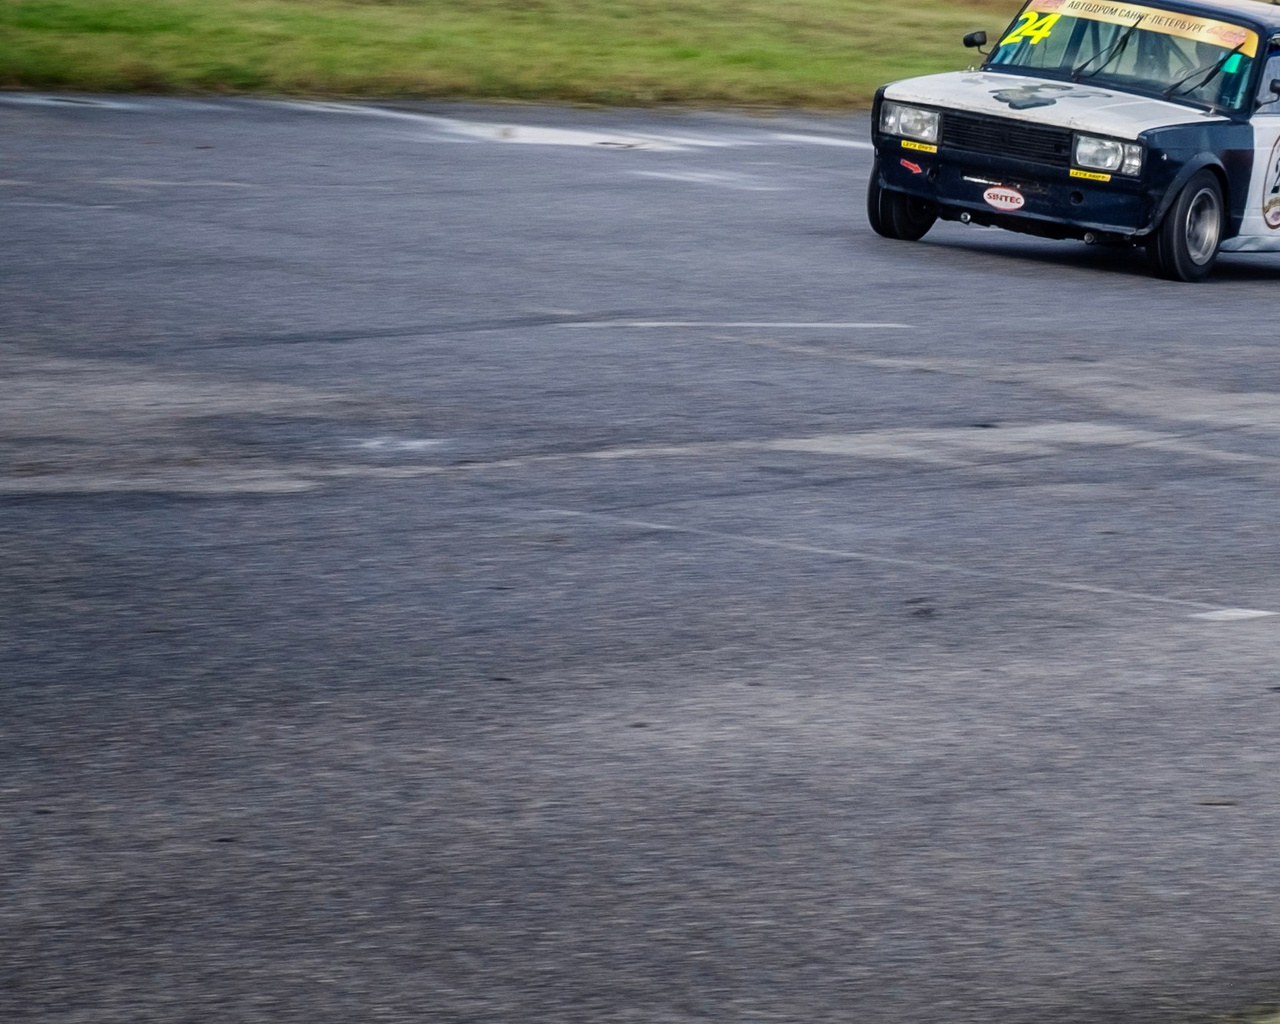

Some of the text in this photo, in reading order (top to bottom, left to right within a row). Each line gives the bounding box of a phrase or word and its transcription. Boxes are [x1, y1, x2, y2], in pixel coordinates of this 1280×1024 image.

[1000, 11, 1062, 46] 24
[1068, 0, 1118, 15] АВТОДРОМ
[1118, 9, 1206, 33] САНКТ-ПЕТЕРБУРГ
[987, 192, 1021, 204] SINTEC
